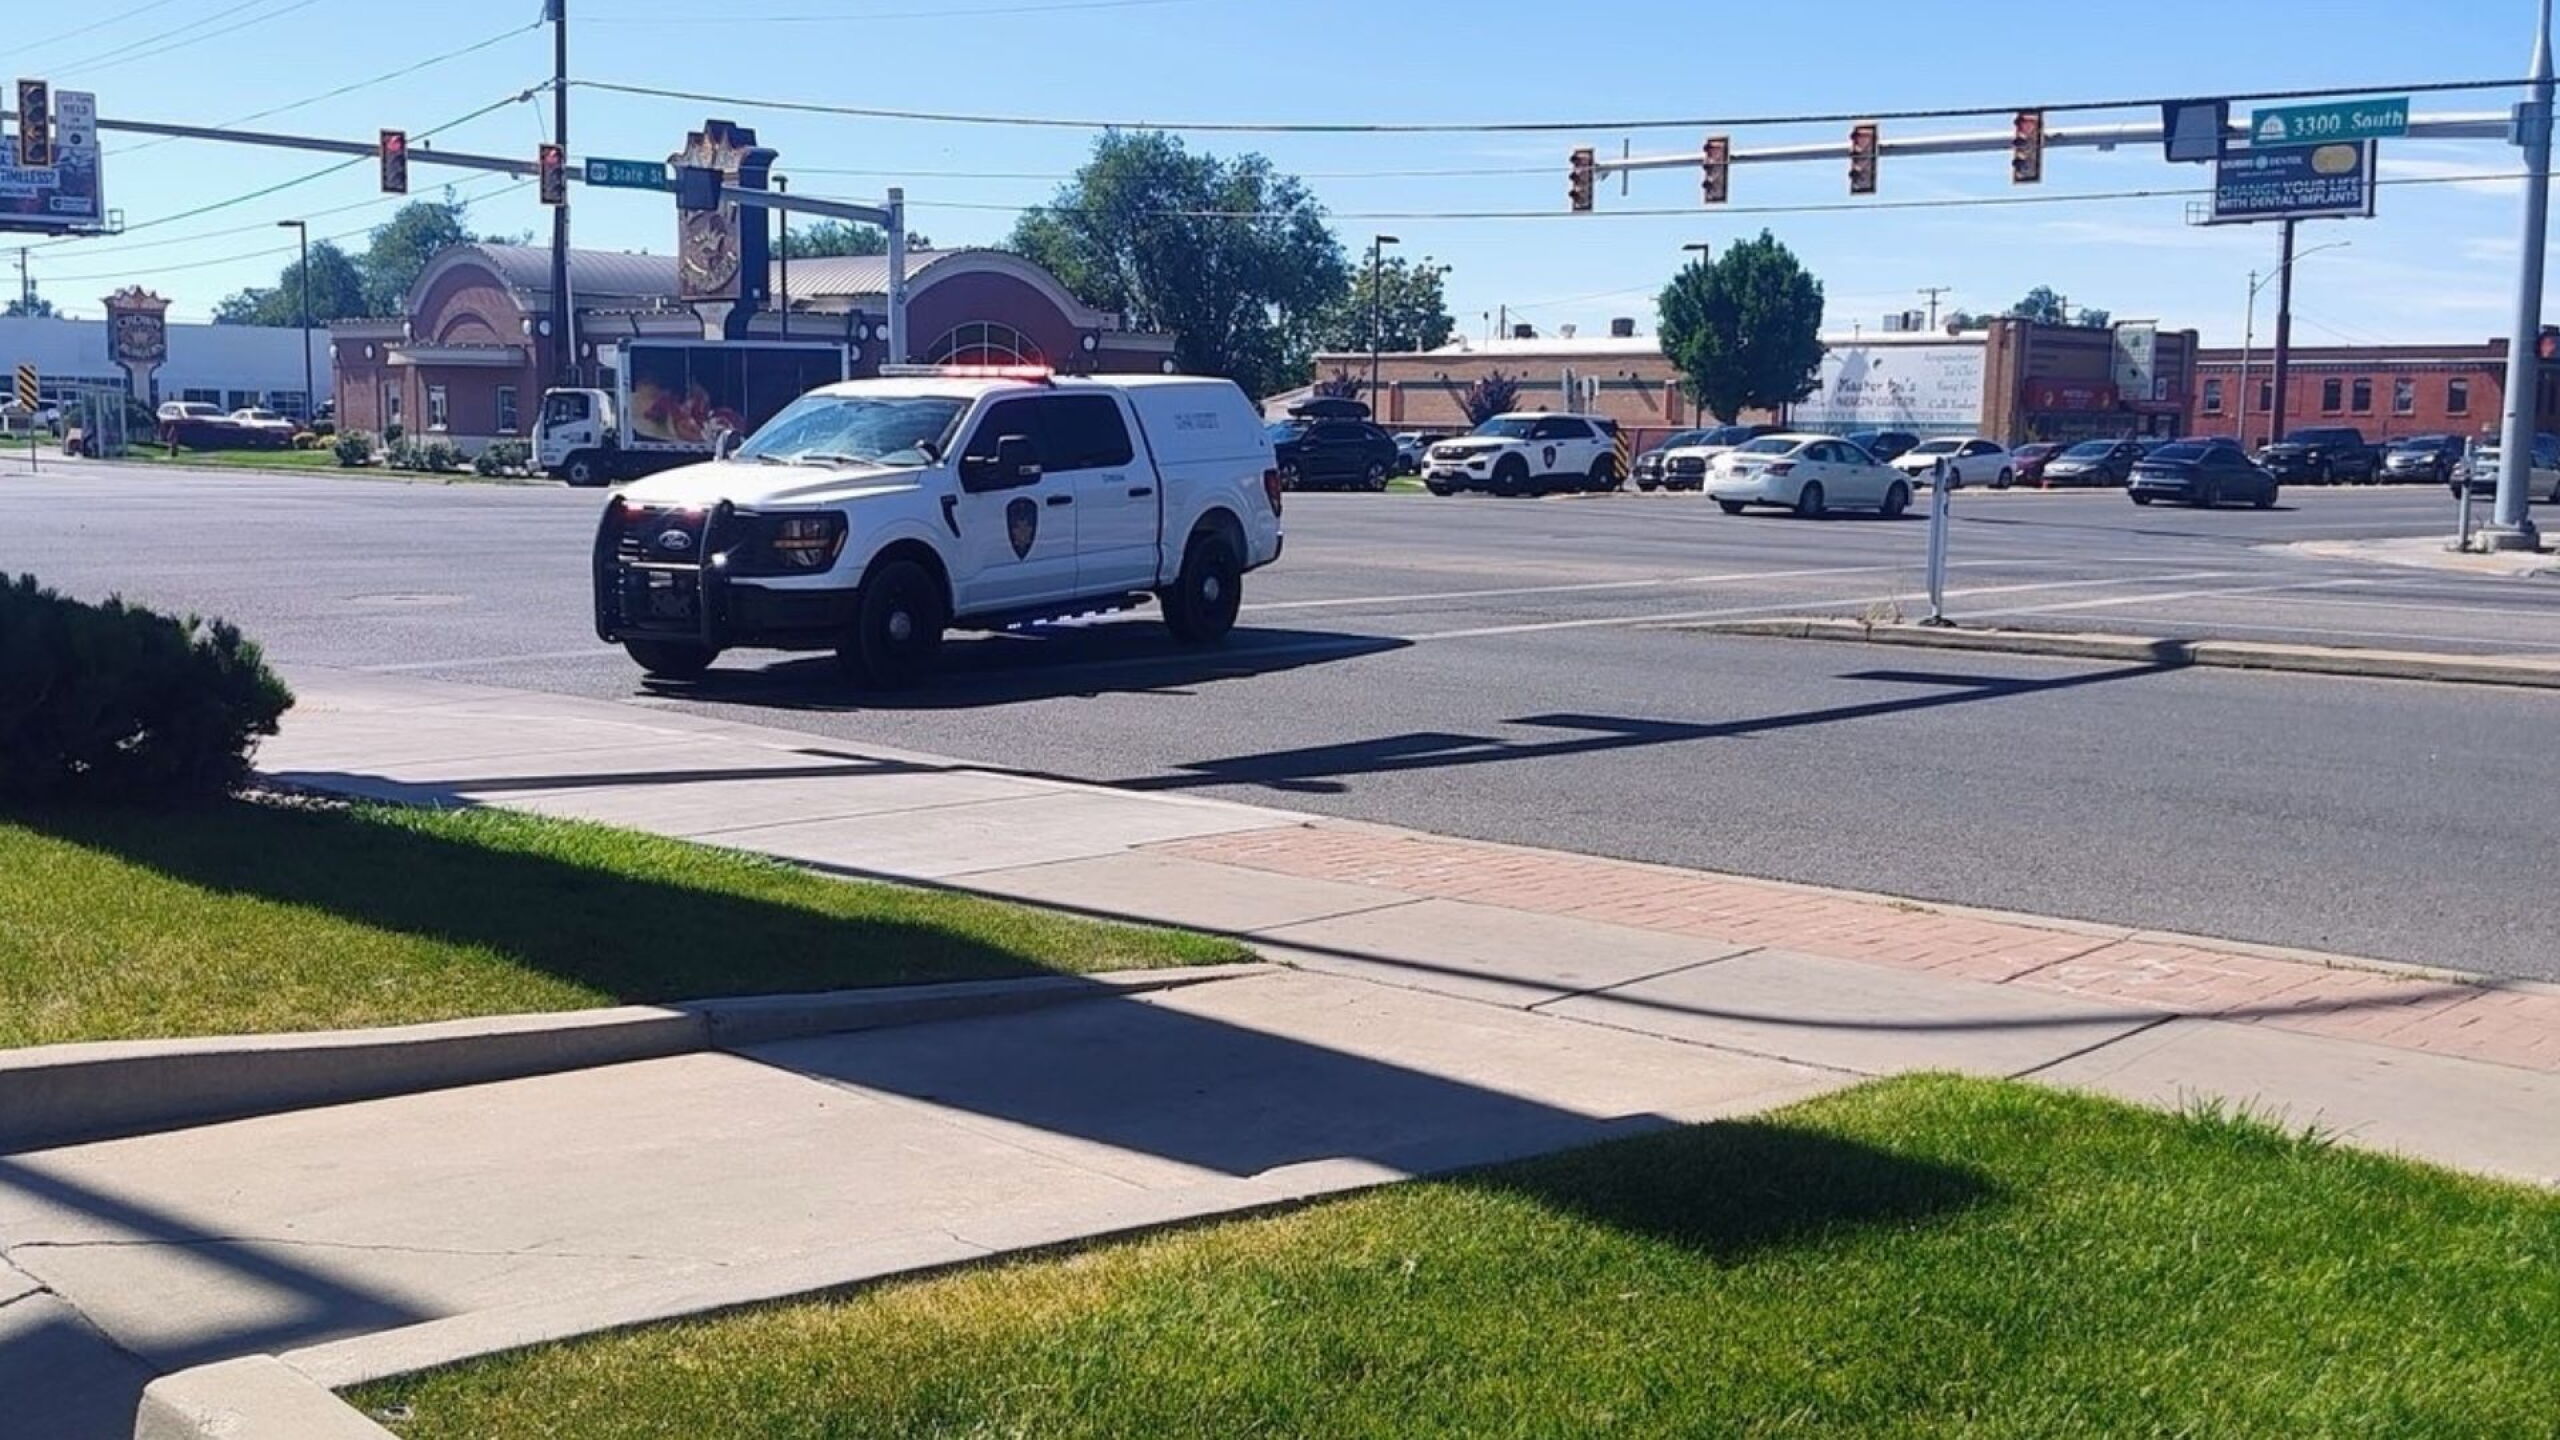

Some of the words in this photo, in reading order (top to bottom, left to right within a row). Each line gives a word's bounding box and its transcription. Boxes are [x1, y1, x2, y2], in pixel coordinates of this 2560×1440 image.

[2294, 113, 2340, 136] 3300
[2352, 111, 2403, 129] South
[612, 165, 644, 182] State
[650, 167, 664, 184] St
[2283, 178, 2326, 194] YOUR
[2329, 176, 2360, 192] LIFE
[2217, 198, 2248, 208] WITH
[2250, 195, 2297, 208] DENTAL
[2298, 191, 2359, 205] IMPLANTS
[662, 532, 687, 548] Ford
